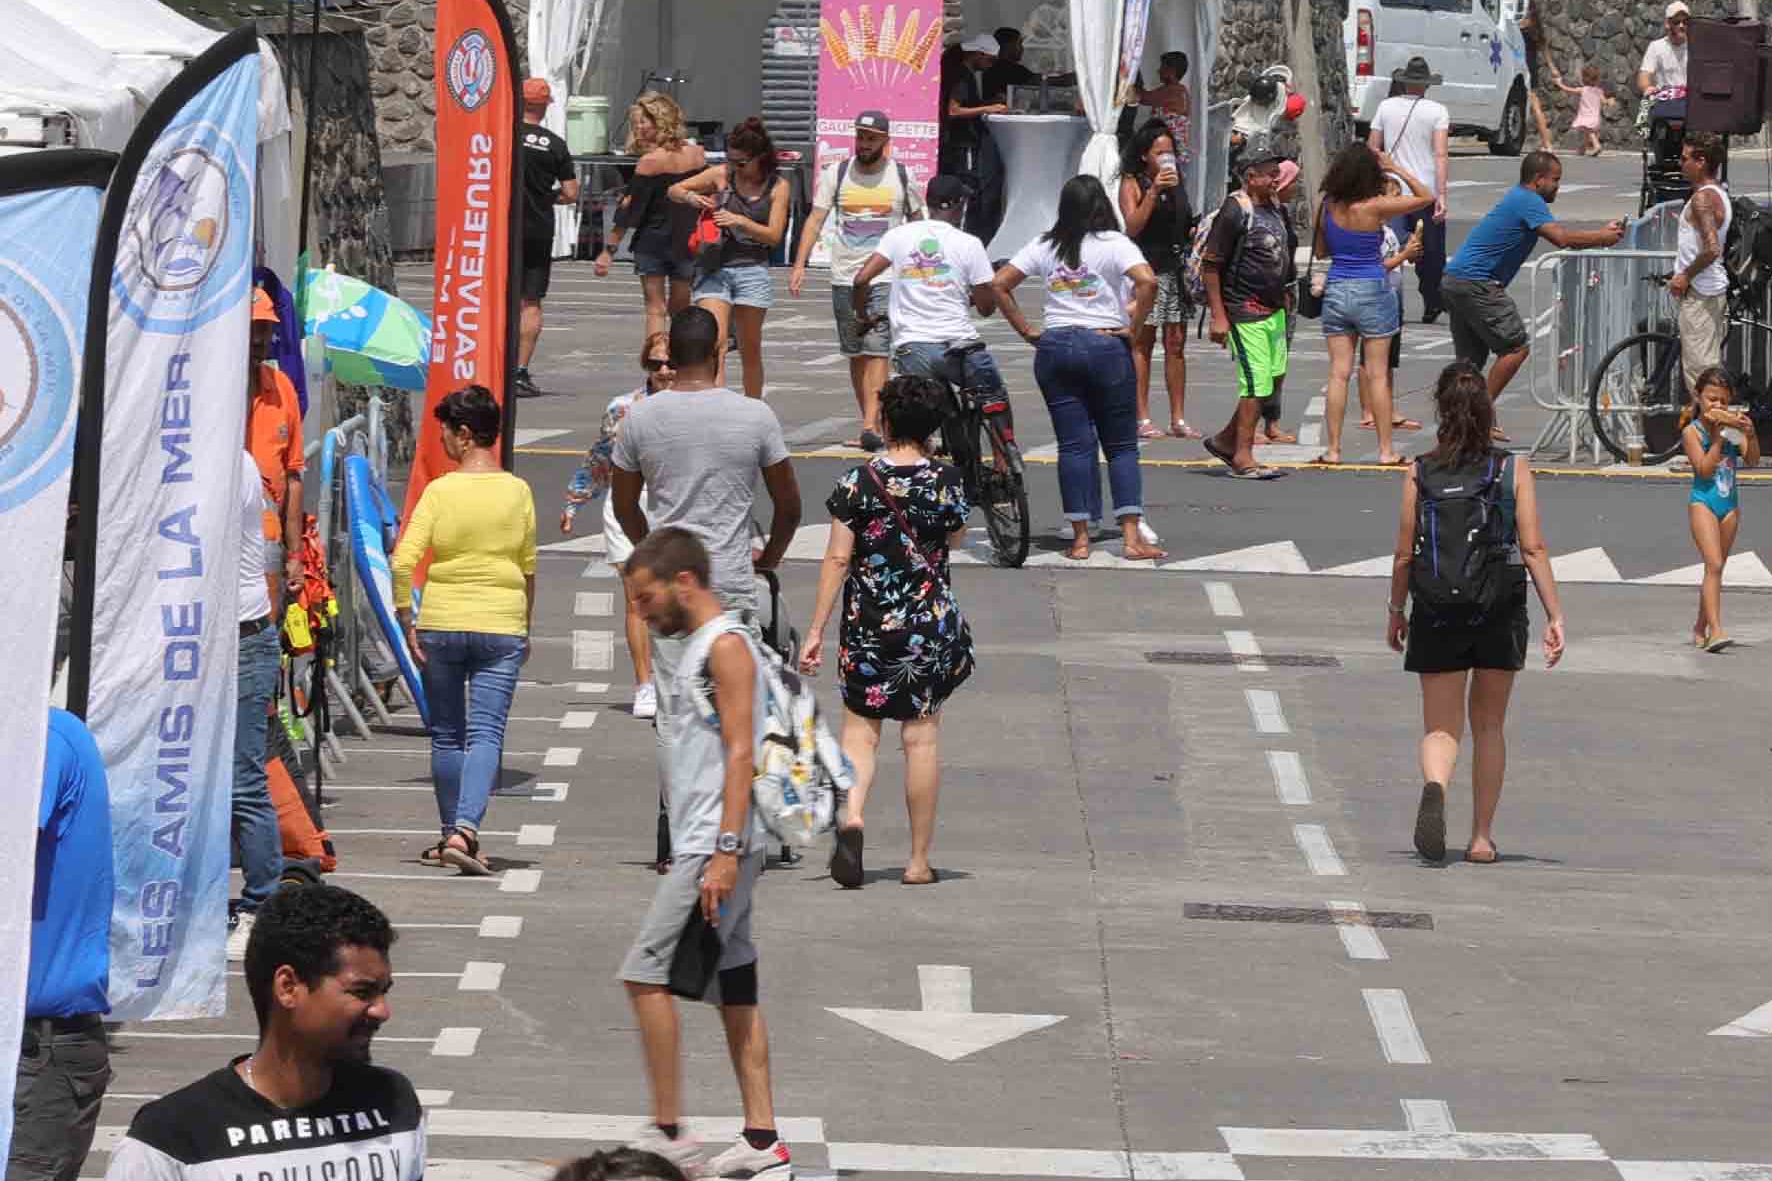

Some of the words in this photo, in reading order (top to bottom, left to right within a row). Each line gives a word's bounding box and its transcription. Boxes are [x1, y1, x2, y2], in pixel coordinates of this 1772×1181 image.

[160, 352, 193, 483] MER
[157, 504, 202, 579] LA
[160, 601, 202, 680] DE
[152, 703, 193, 857] AMIS
[137, 881, 177, 987] LES
[226, 1108, 390, 1147] PARENTAL
